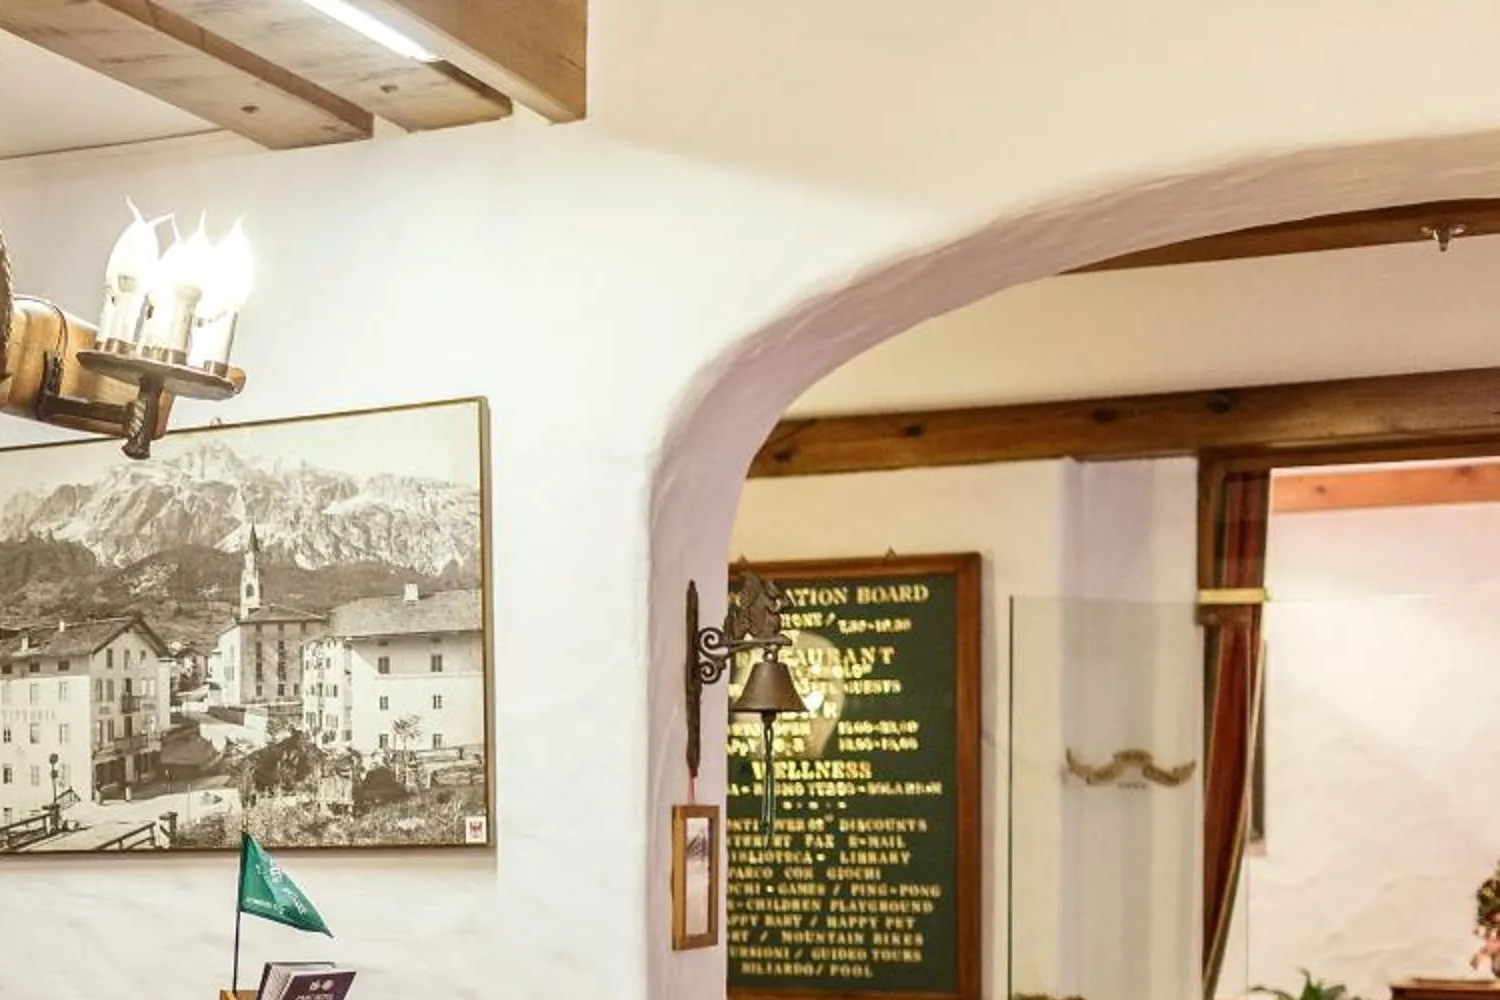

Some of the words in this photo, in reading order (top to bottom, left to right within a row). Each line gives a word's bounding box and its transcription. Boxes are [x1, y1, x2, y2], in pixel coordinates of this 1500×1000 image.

[857, 585, 929, 605] BOARD
[751, 760, 872, 780] WELLNESS
[839, 851, 912, 865] LIBRARY
[829, 899, 934, 913] PLAYGROUND
[826, 915, 878, 929] HAPPY
[781, 930, 865, 944] MOUNTAIN
[872, 931, 924, 946] BIKES
[830, 962, 874, 979] POOL
